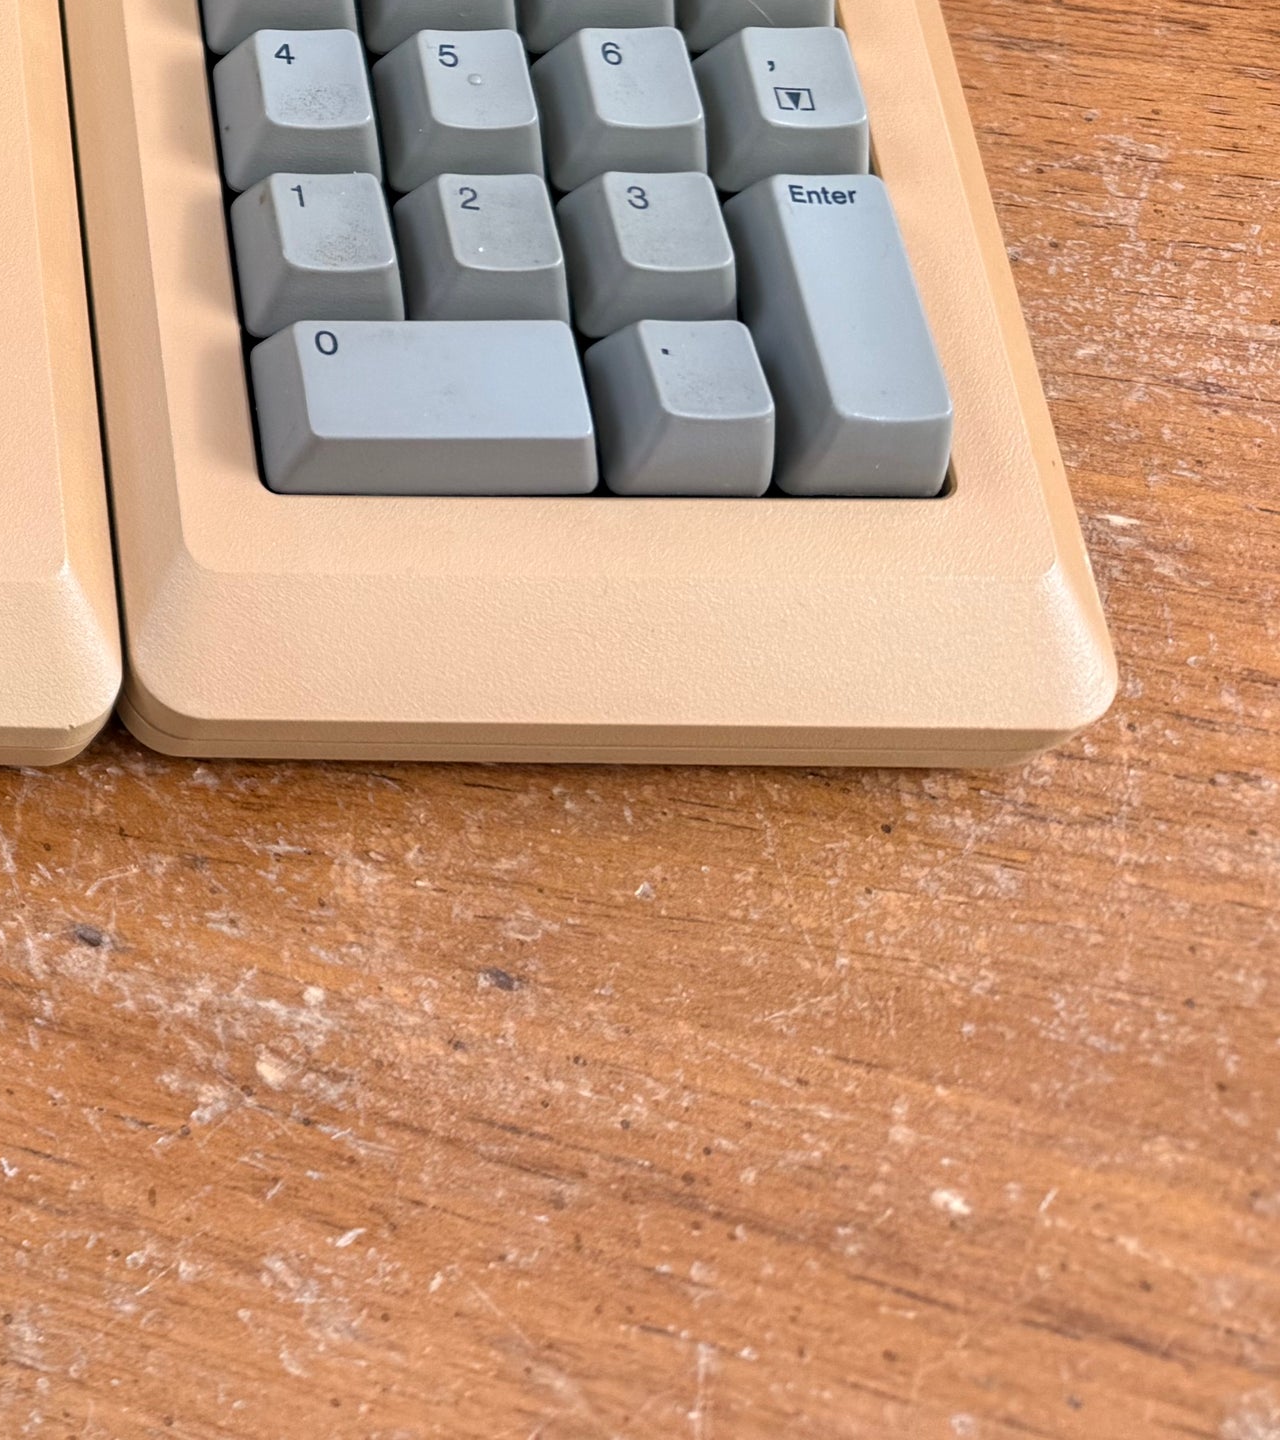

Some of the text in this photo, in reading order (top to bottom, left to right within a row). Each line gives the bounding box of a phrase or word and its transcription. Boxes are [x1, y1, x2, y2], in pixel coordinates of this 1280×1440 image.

[273, 43, 296, 66] 4
[437, 43, 460, 69] 5
[600, 41, 624, 66] 6
[766, 60, 776, 73] ,
[290, 184, 306, 208] 1
[458, 186, 481, 212] 2
[626, 185, 650, 210] 3
[787, 183, 857, 205] Enter
[314, 330, 339, 357] 0
[660, 347, 671, 356] .
